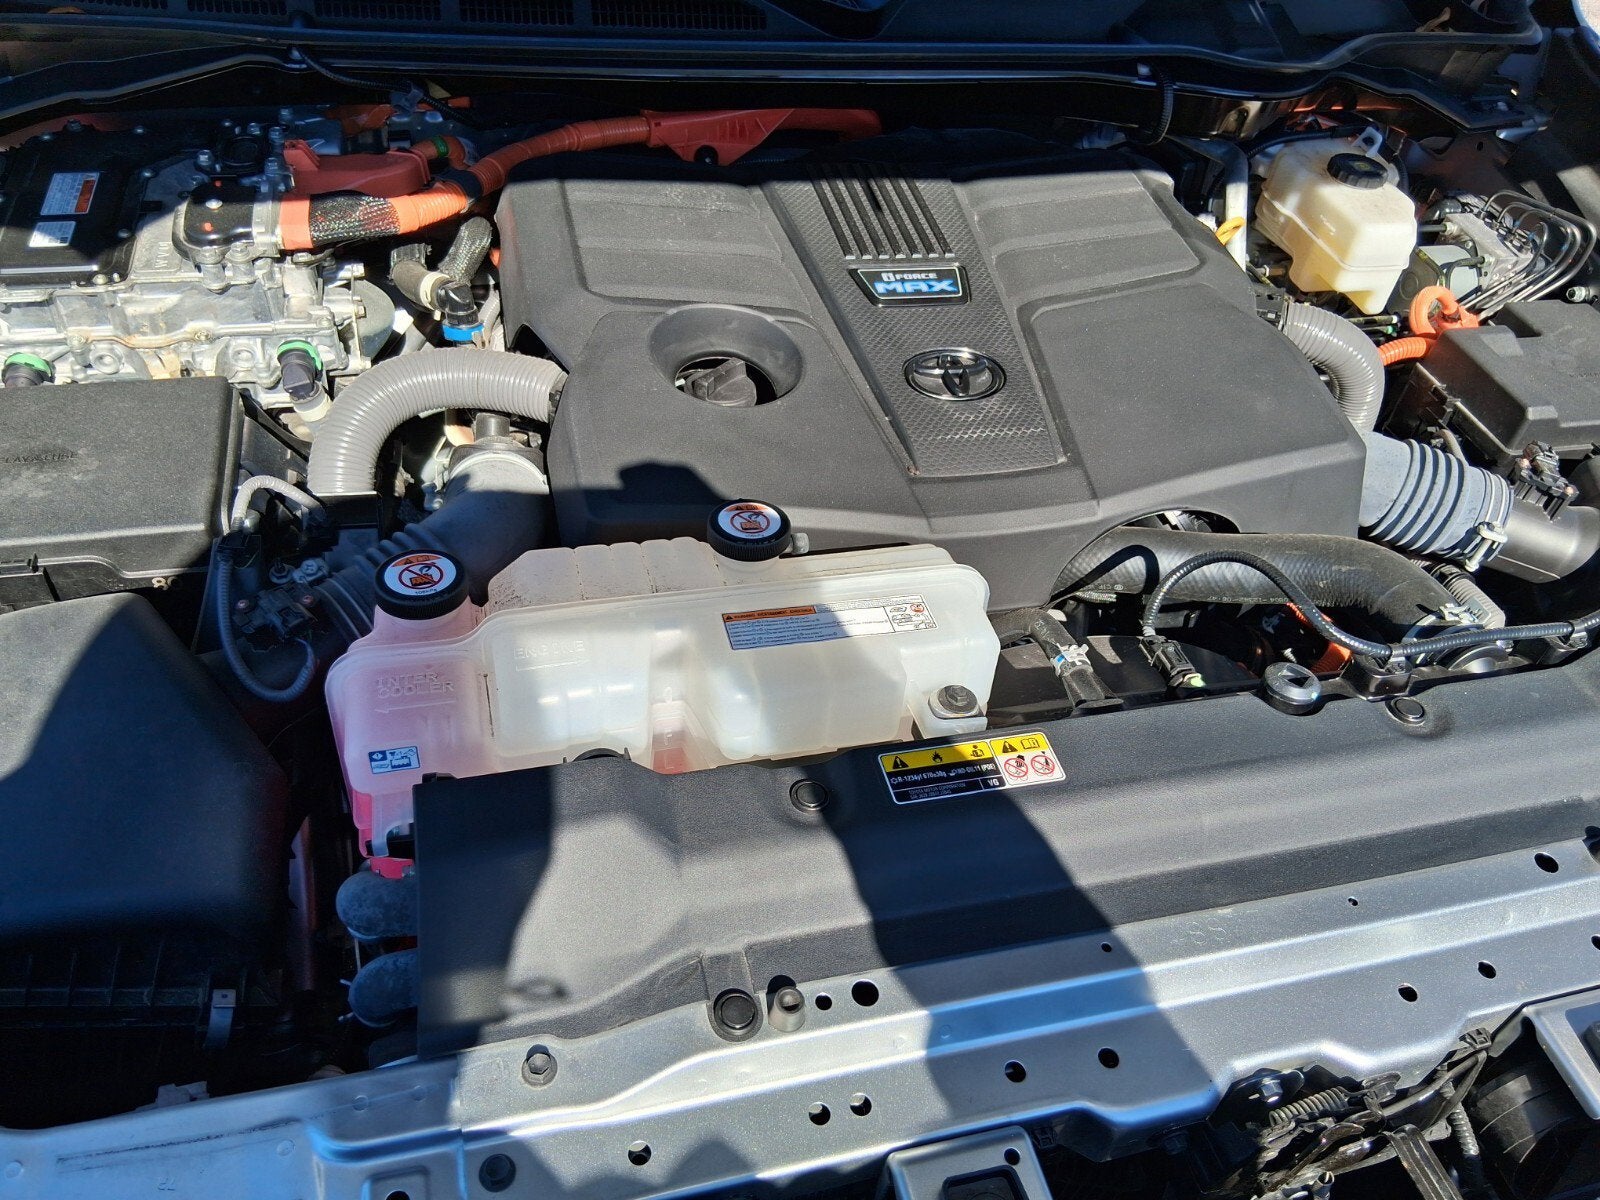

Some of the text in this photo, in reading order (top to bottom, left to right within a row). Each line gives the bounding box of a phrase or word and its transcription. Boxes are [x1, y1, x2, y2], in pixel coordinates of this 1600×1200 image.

[874, 279, 958, 294] MAX
[514, 640, 586, 659] ENGINE
[378, 672, 438, 687] INTER
[378, 682, 454, 699] COOLER
[988, 779, 1000, 787] VG
